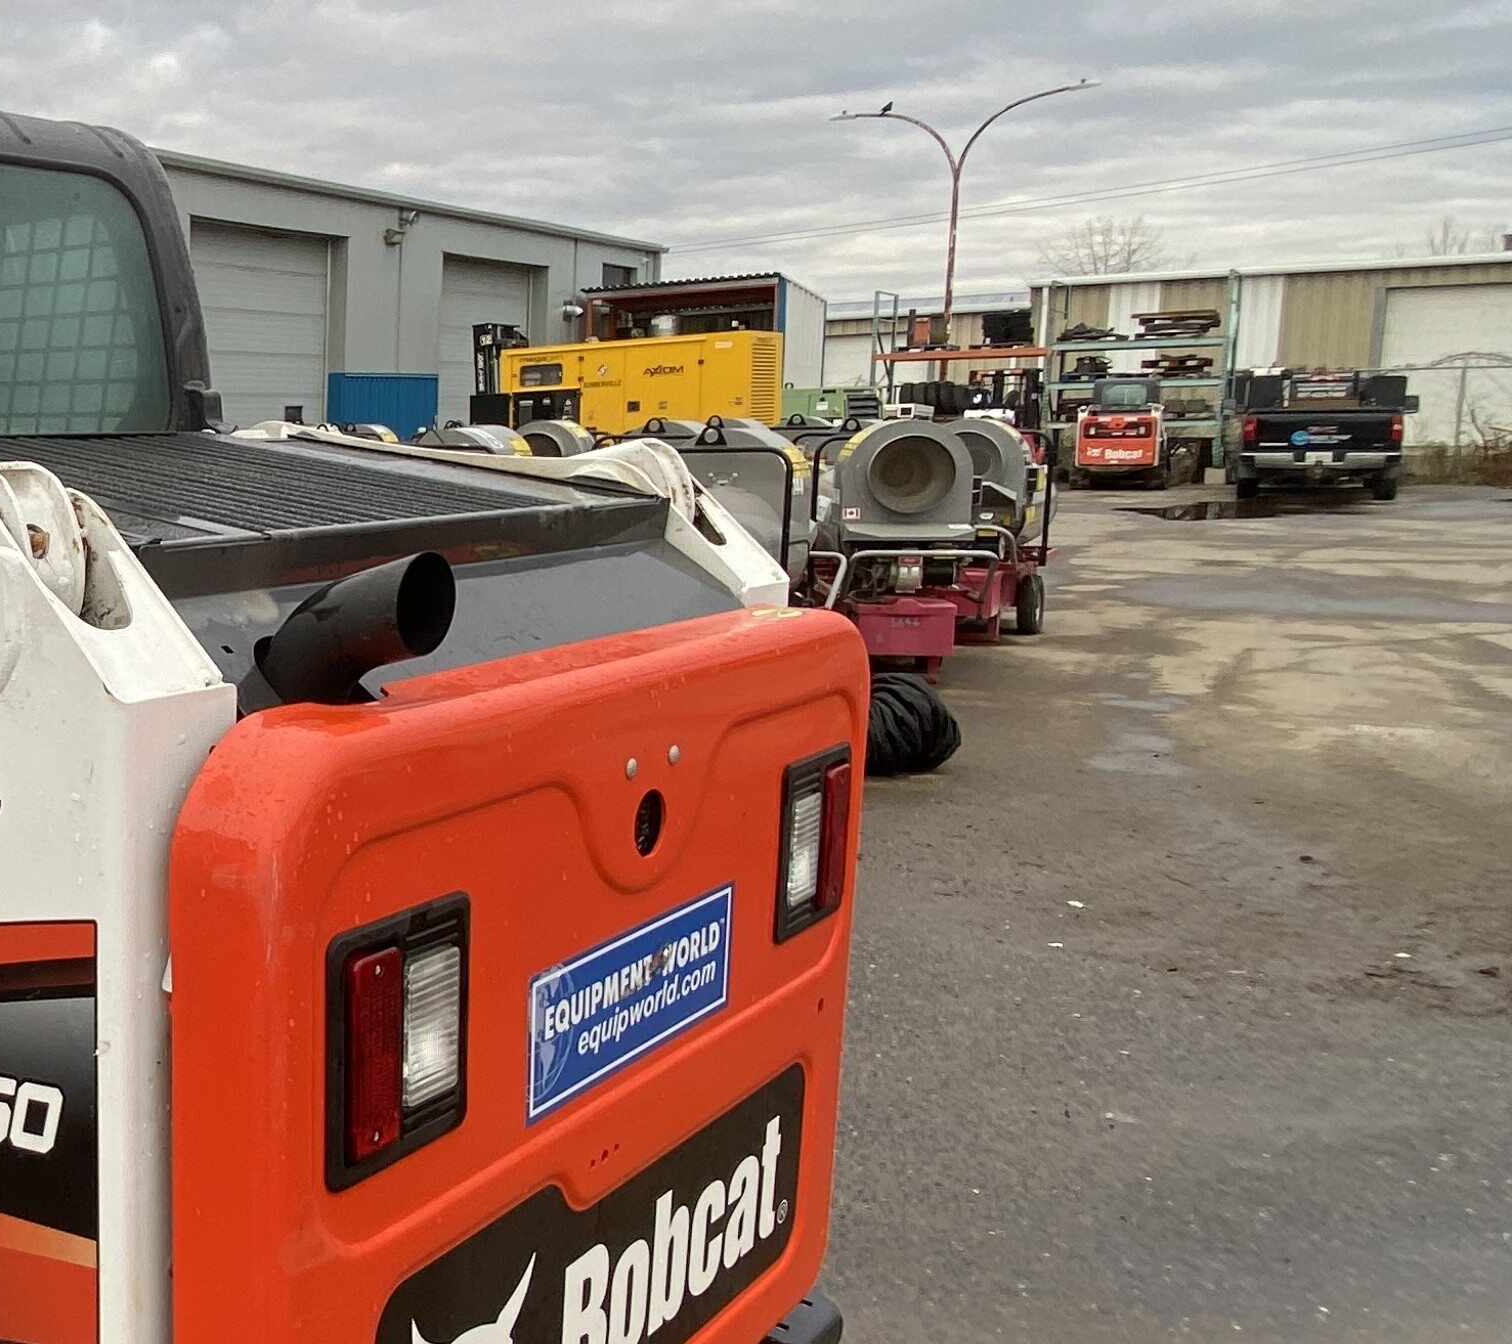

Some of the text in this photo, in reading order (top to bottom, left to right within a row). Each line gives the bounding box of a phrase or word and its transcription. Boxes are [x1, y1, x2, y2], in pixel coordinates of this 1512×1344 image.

[544, 921, 721, 1041] EQUIPMENT WORLD
[577, 960, 716, 1056] equipworld.com
